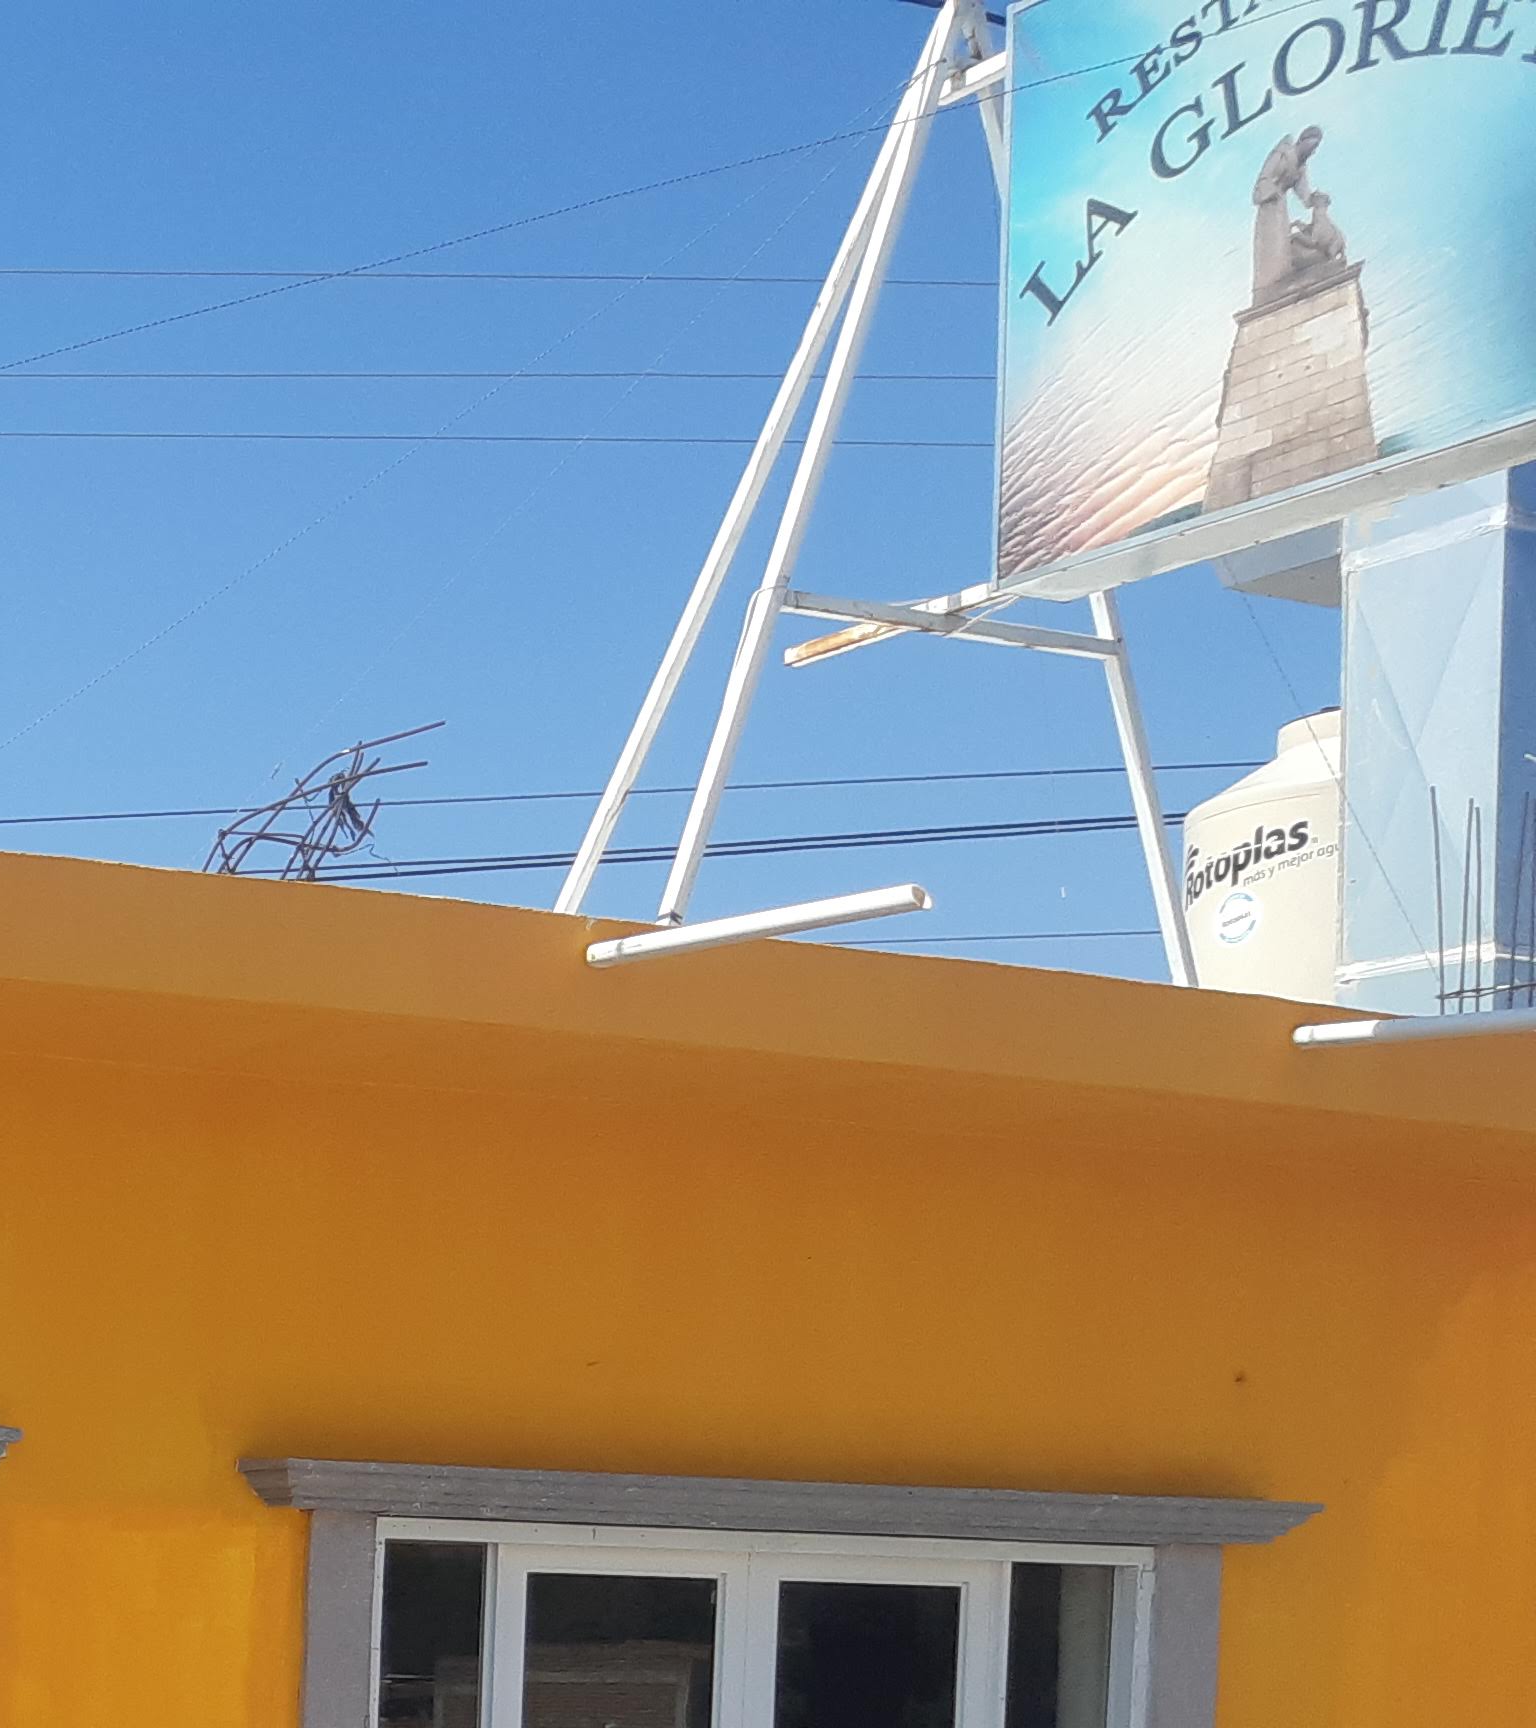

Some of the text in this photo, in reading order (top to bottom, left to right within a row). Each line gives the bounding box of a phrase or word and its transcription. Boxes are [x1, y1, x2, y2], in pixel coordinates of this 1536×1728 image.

[1086, 0, 1260, 143] REST
[1020, 0, 1536, 327] LA GLORIE
[1278, 851, 1314, 872] mejor
